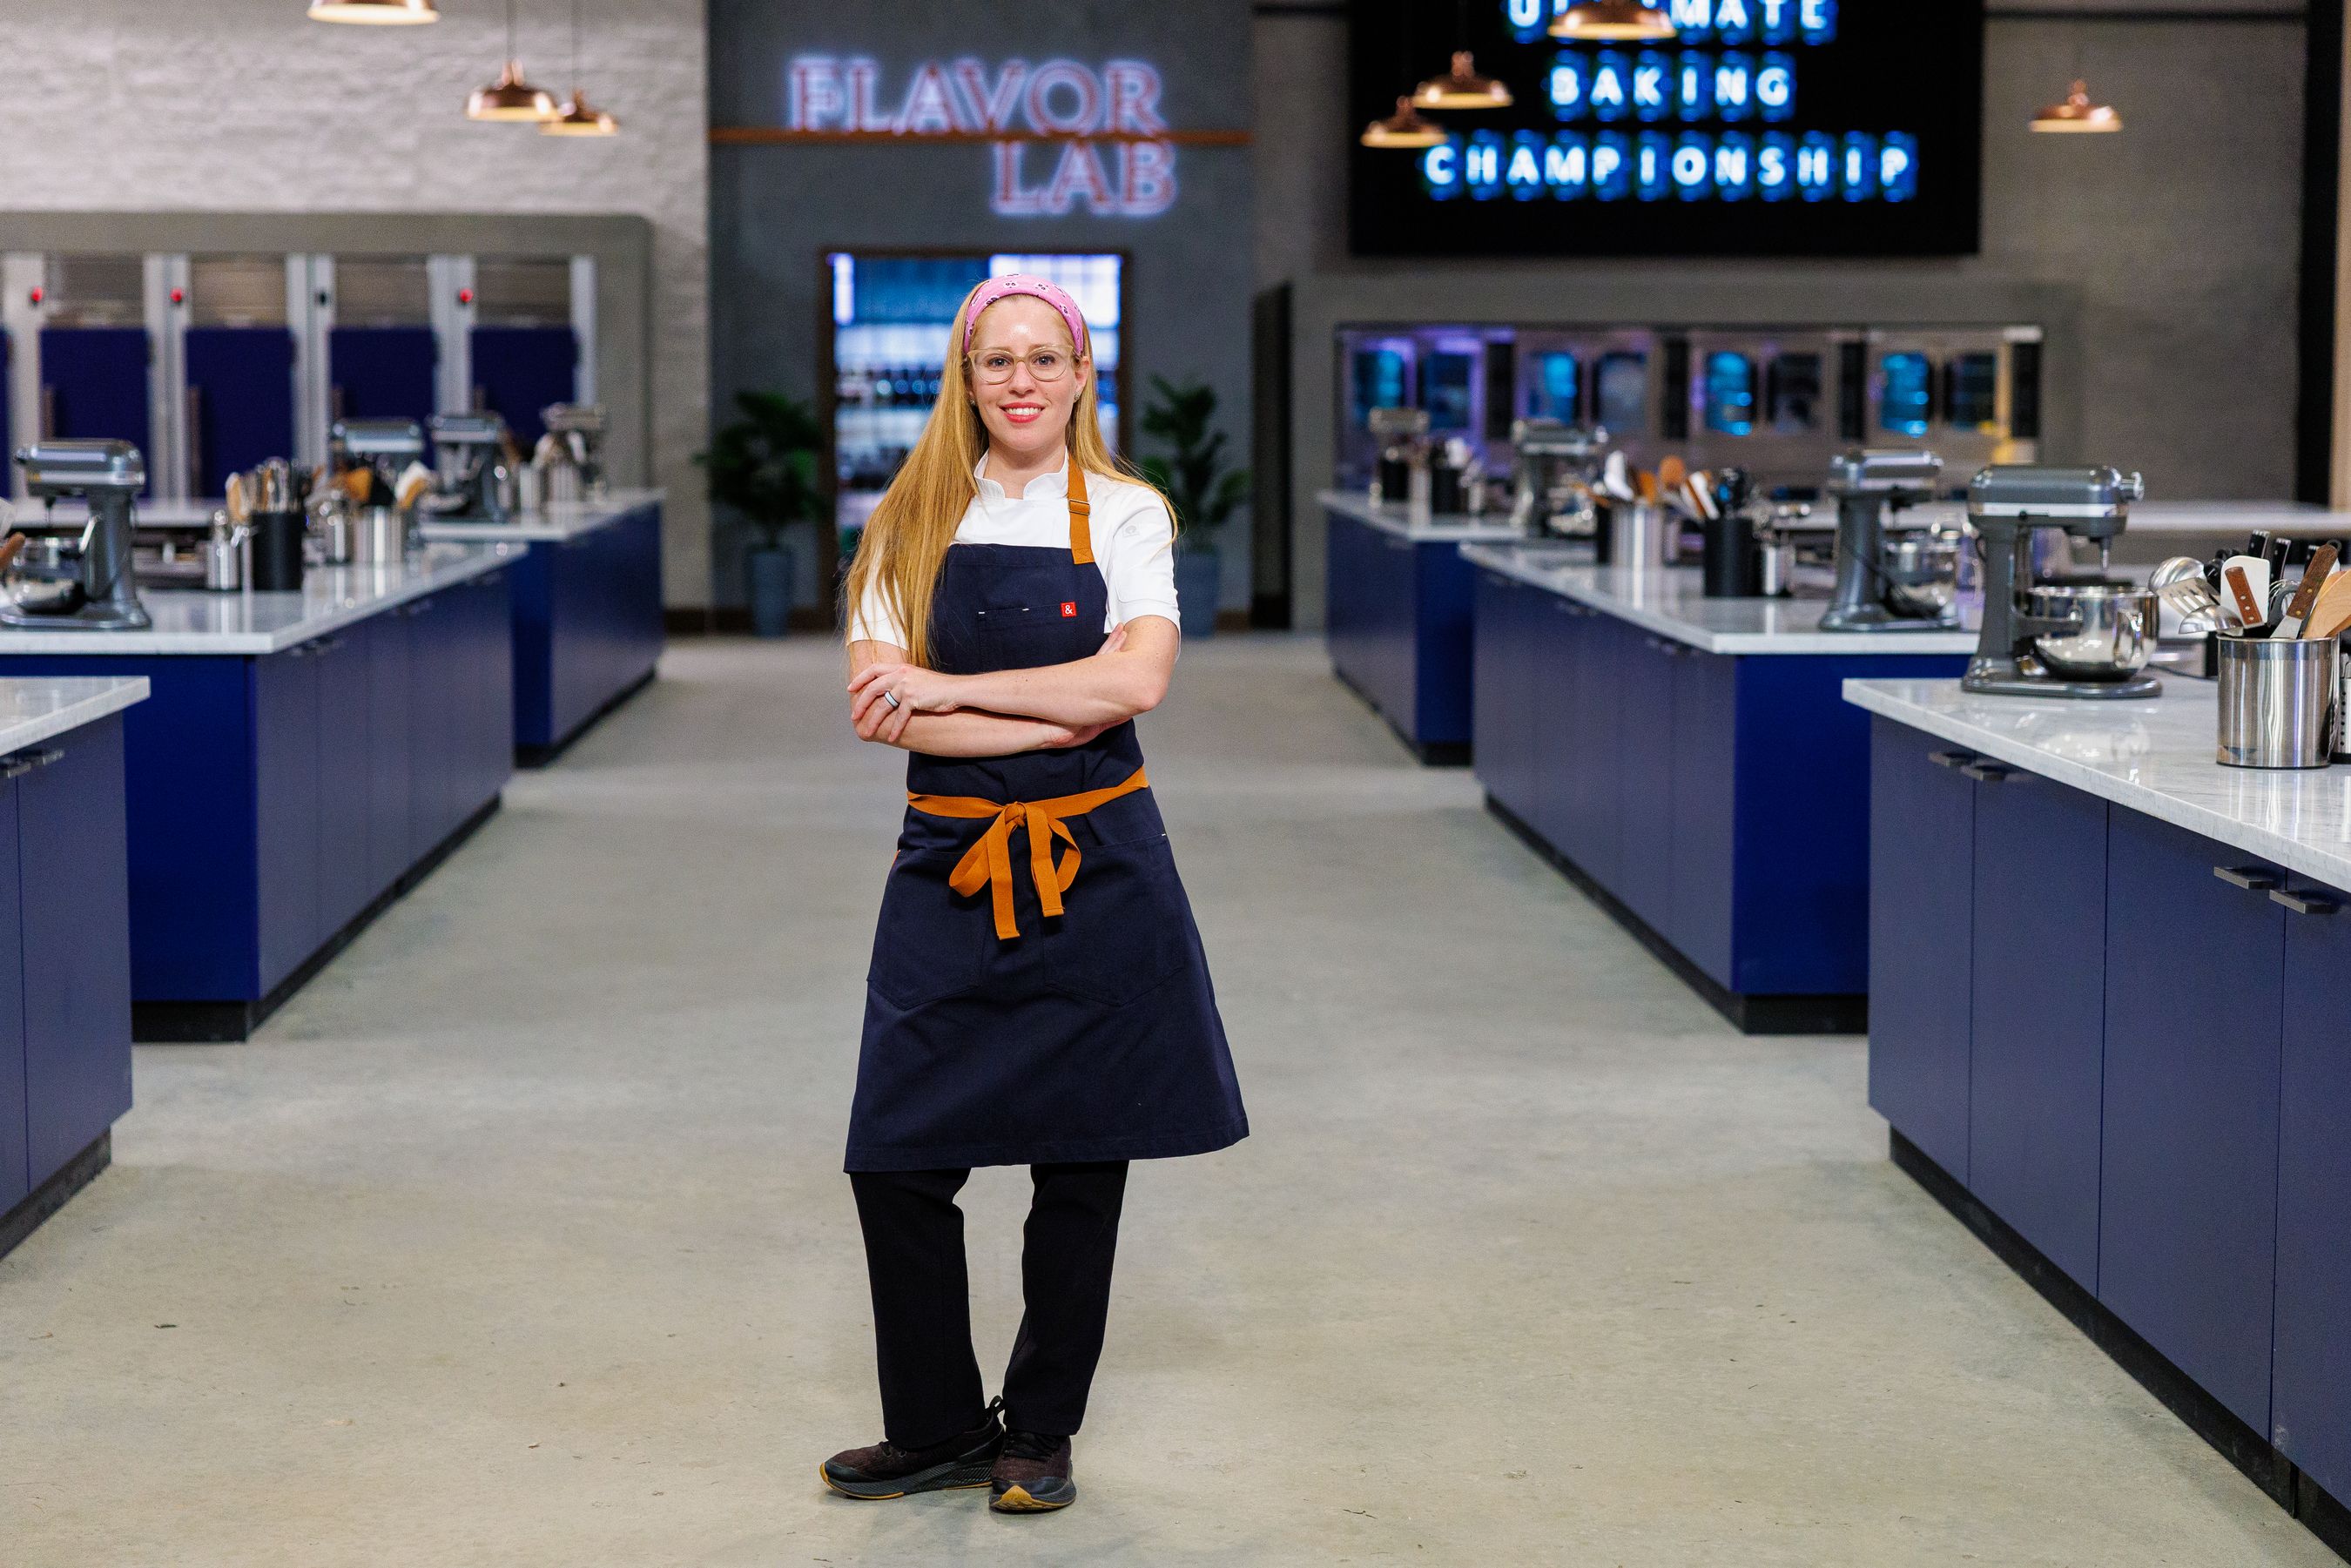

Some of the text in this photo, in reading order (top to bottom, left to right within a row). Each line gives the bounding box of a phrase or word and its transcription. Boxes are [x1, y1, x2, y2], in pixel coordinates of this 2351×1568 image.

[1509, 0, 1826, 28] UMATE
[789, 56, 1167, 134] FLAVOR
[1550, 66, 1789, 106] BAKING
[991, 139, 1176, 215] LAB
[1424, 145, 1909, 185] CHAMPIONSHIP
[1065, 604, 1073, 615] &
